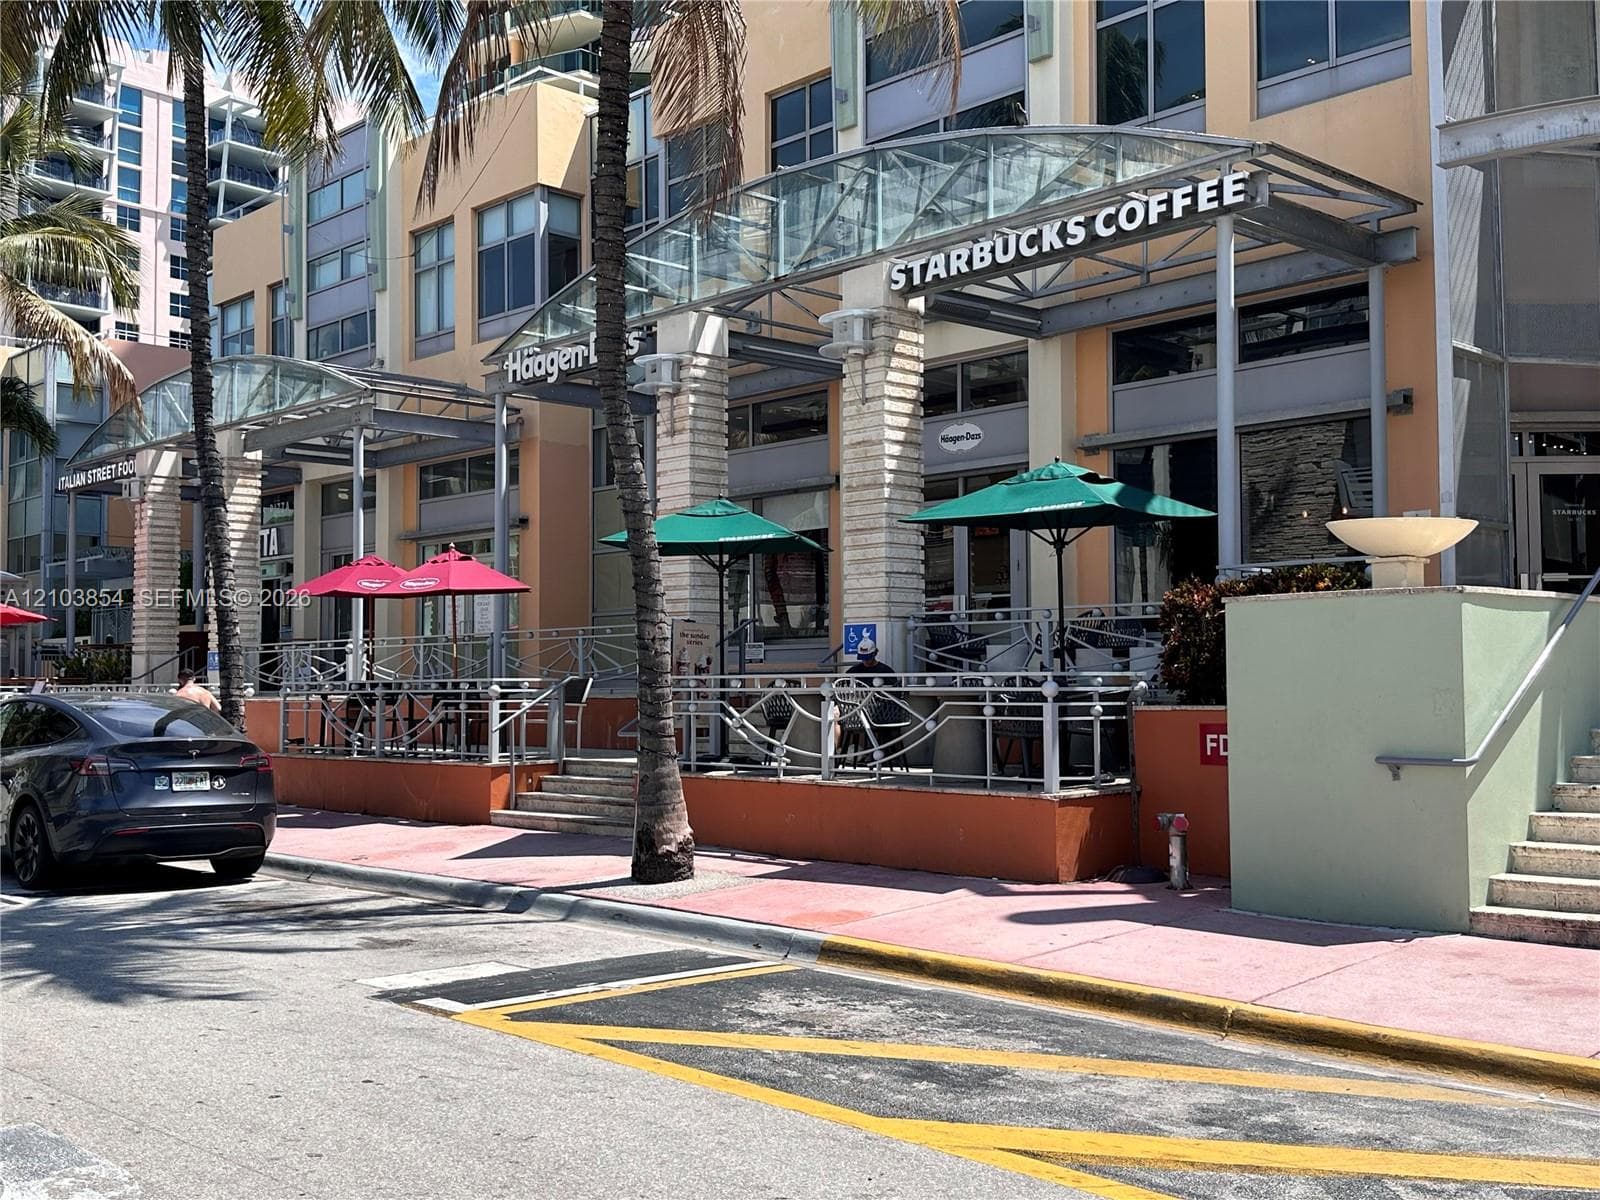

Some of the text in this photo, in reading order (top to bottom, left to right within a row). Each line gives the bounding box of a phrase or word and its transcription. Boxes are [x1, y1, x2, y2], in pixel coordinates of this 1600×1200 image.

[889, 171, 1248, 291] STARBUCKS COFFEE
[508, 331, 640, 383] Häagen-s
[940, 431, 982, 445] Häagen-Dazs
[58, 459, 137, 491] ITALIAN STREET FOO
